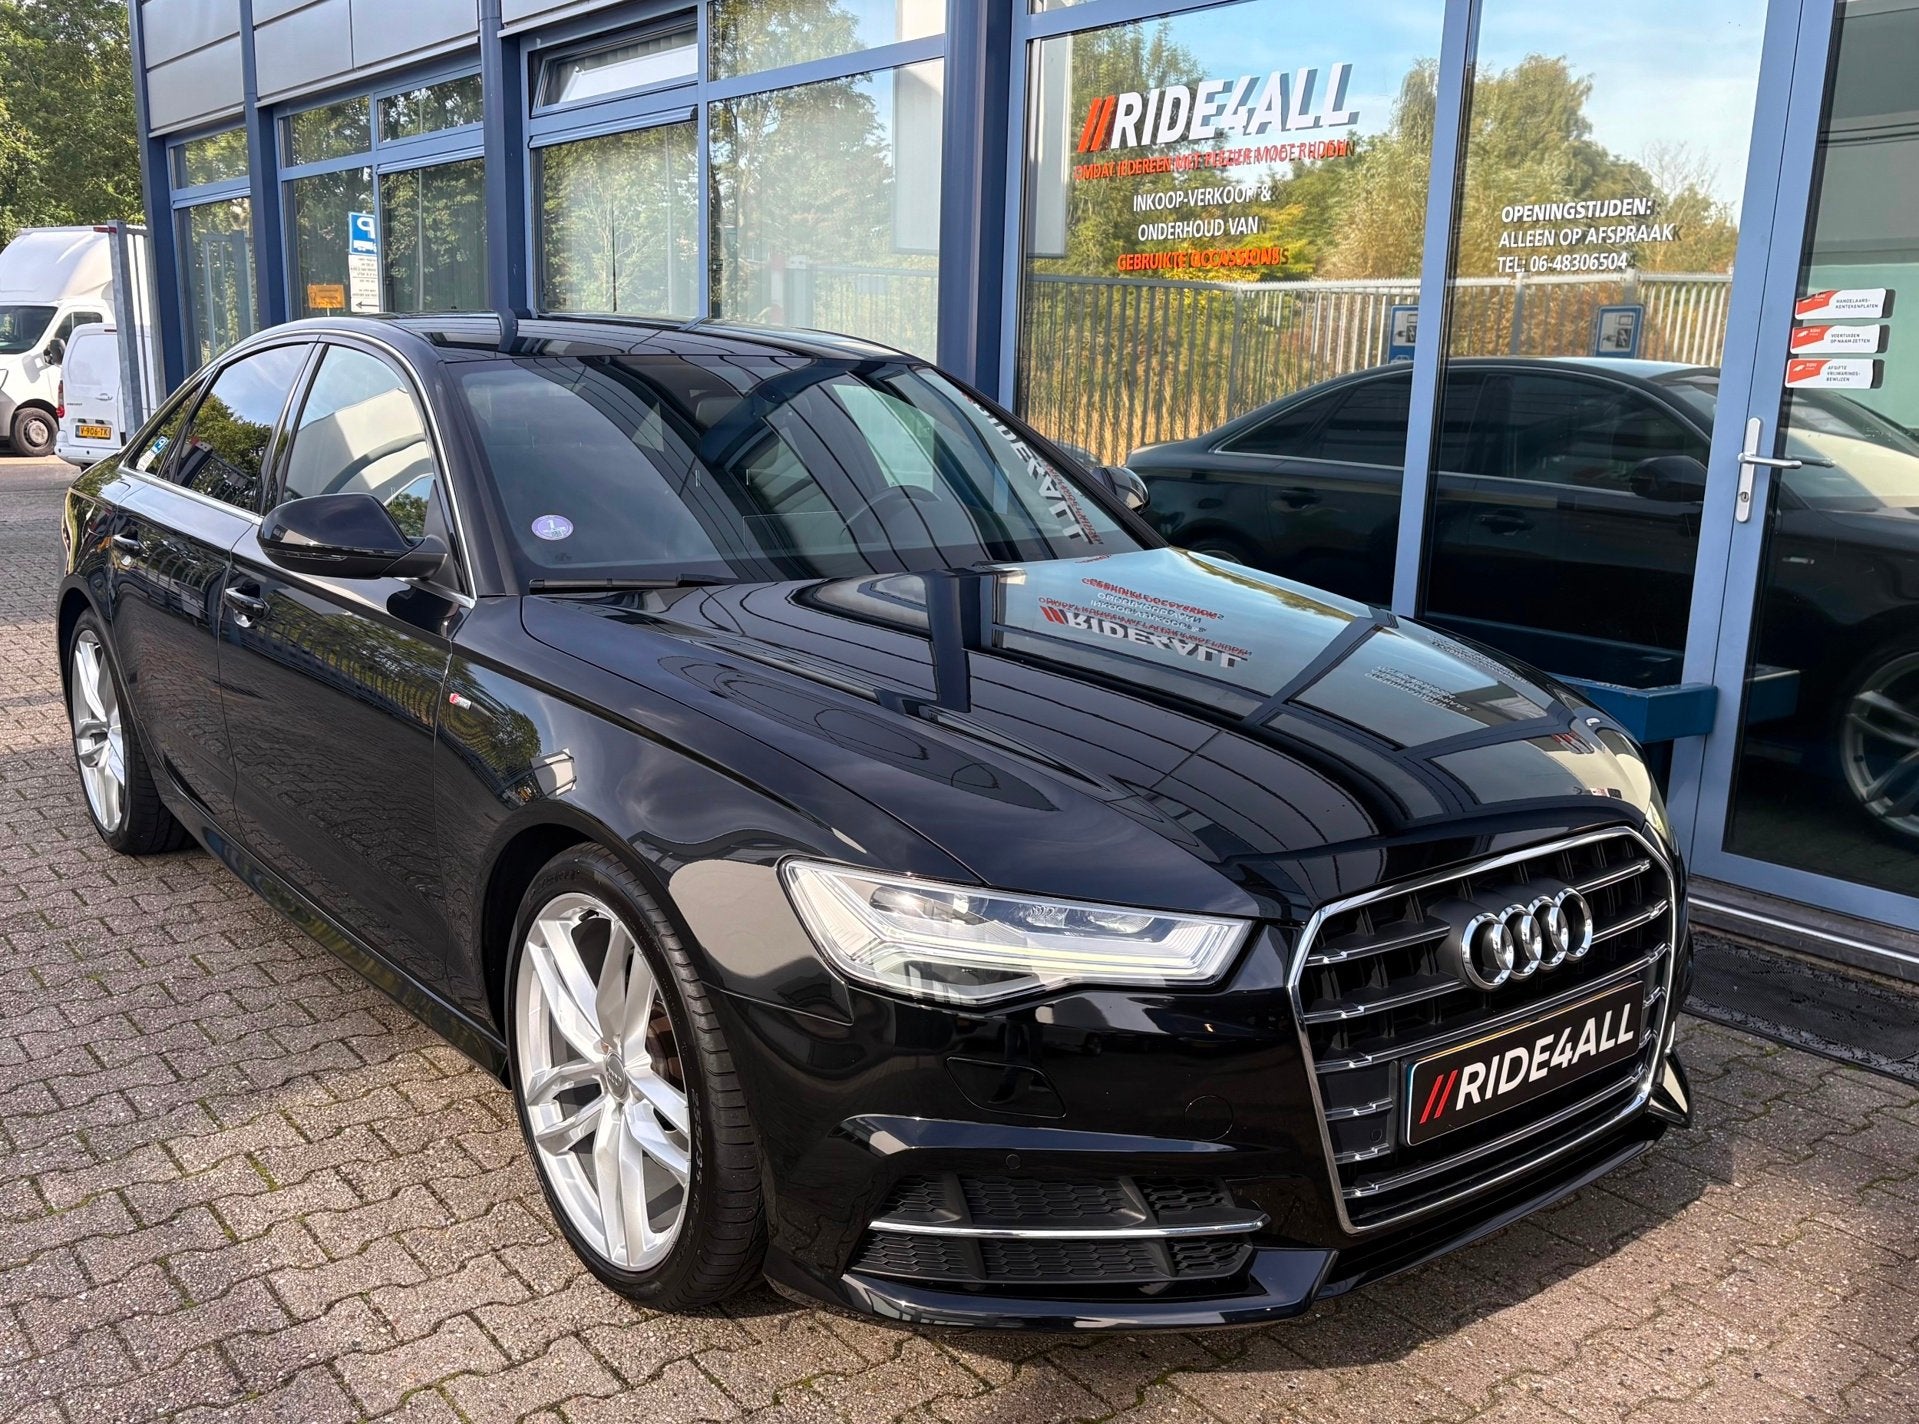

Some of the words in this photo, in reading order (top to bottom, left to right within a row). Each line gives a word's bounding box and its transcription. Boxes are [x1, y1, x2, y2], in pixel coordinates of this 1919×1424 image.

[1501, 197, 1652, 224] OPENINGSTIJDEN:
[1138, 218, 1225, 242] ONDERHOUD
[1229, 216, 1260, 235] VAN
[1498, 229, 1555, 248] ALLEEN
[1559, 228, 1582, 246] OP
[1585, 222, 1676, 244] AFSPRAAK
[1117, 250, 1186, 271] GEBRUIKTE
[1497, 256, 1526, 273] TEL:
[1530, 252, 1629, 272] 06-48306504
